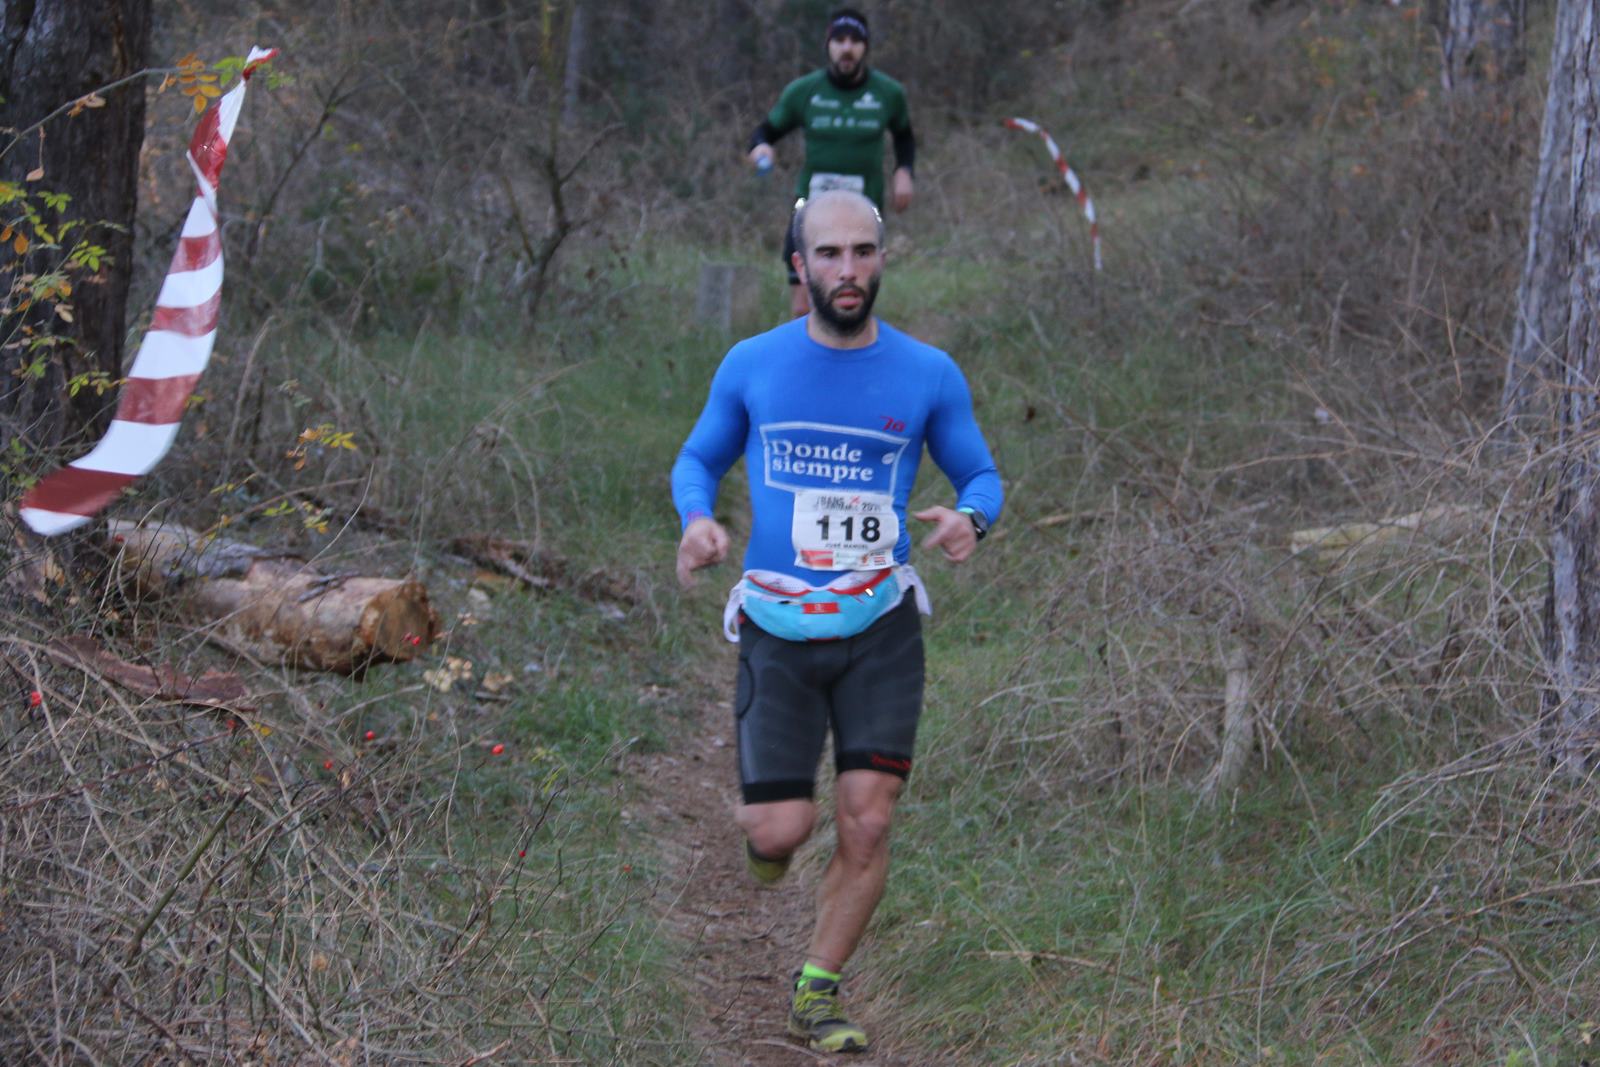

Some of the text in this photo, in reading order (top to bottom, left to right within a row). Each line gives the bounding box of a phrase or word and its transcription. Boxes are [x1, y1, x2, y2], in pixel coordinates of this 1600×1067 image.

[769, 439, 863, 463] Donde
[771, 455, 874, 484] siempre
[816, 514, 881, 543] 118
